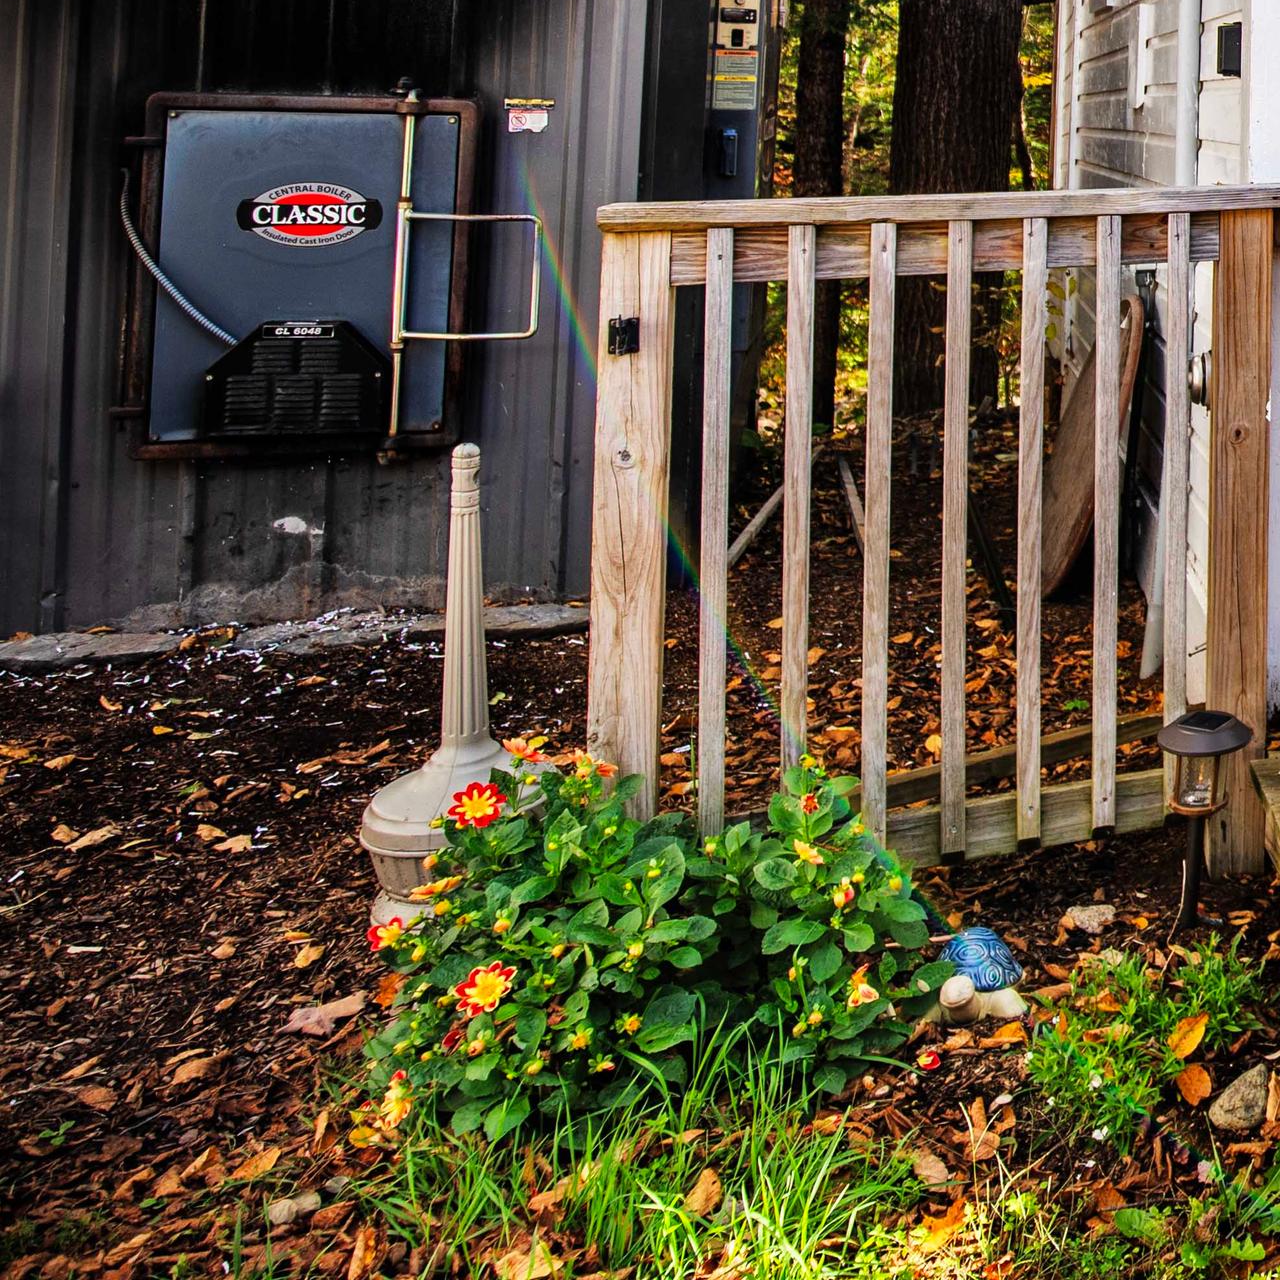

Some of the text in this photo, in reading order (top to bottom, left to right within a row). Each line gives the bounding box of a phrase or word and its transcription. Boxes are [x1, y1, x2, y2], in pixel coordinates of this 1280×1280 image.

[268, 184, 352, 201] CENTRAL BOILER
[252, 204, 366, 225] CLASSIC
[261, 228, 355, 245] Insulated Cast Iron Door
[275, 327, 322, 335] CL 6048
